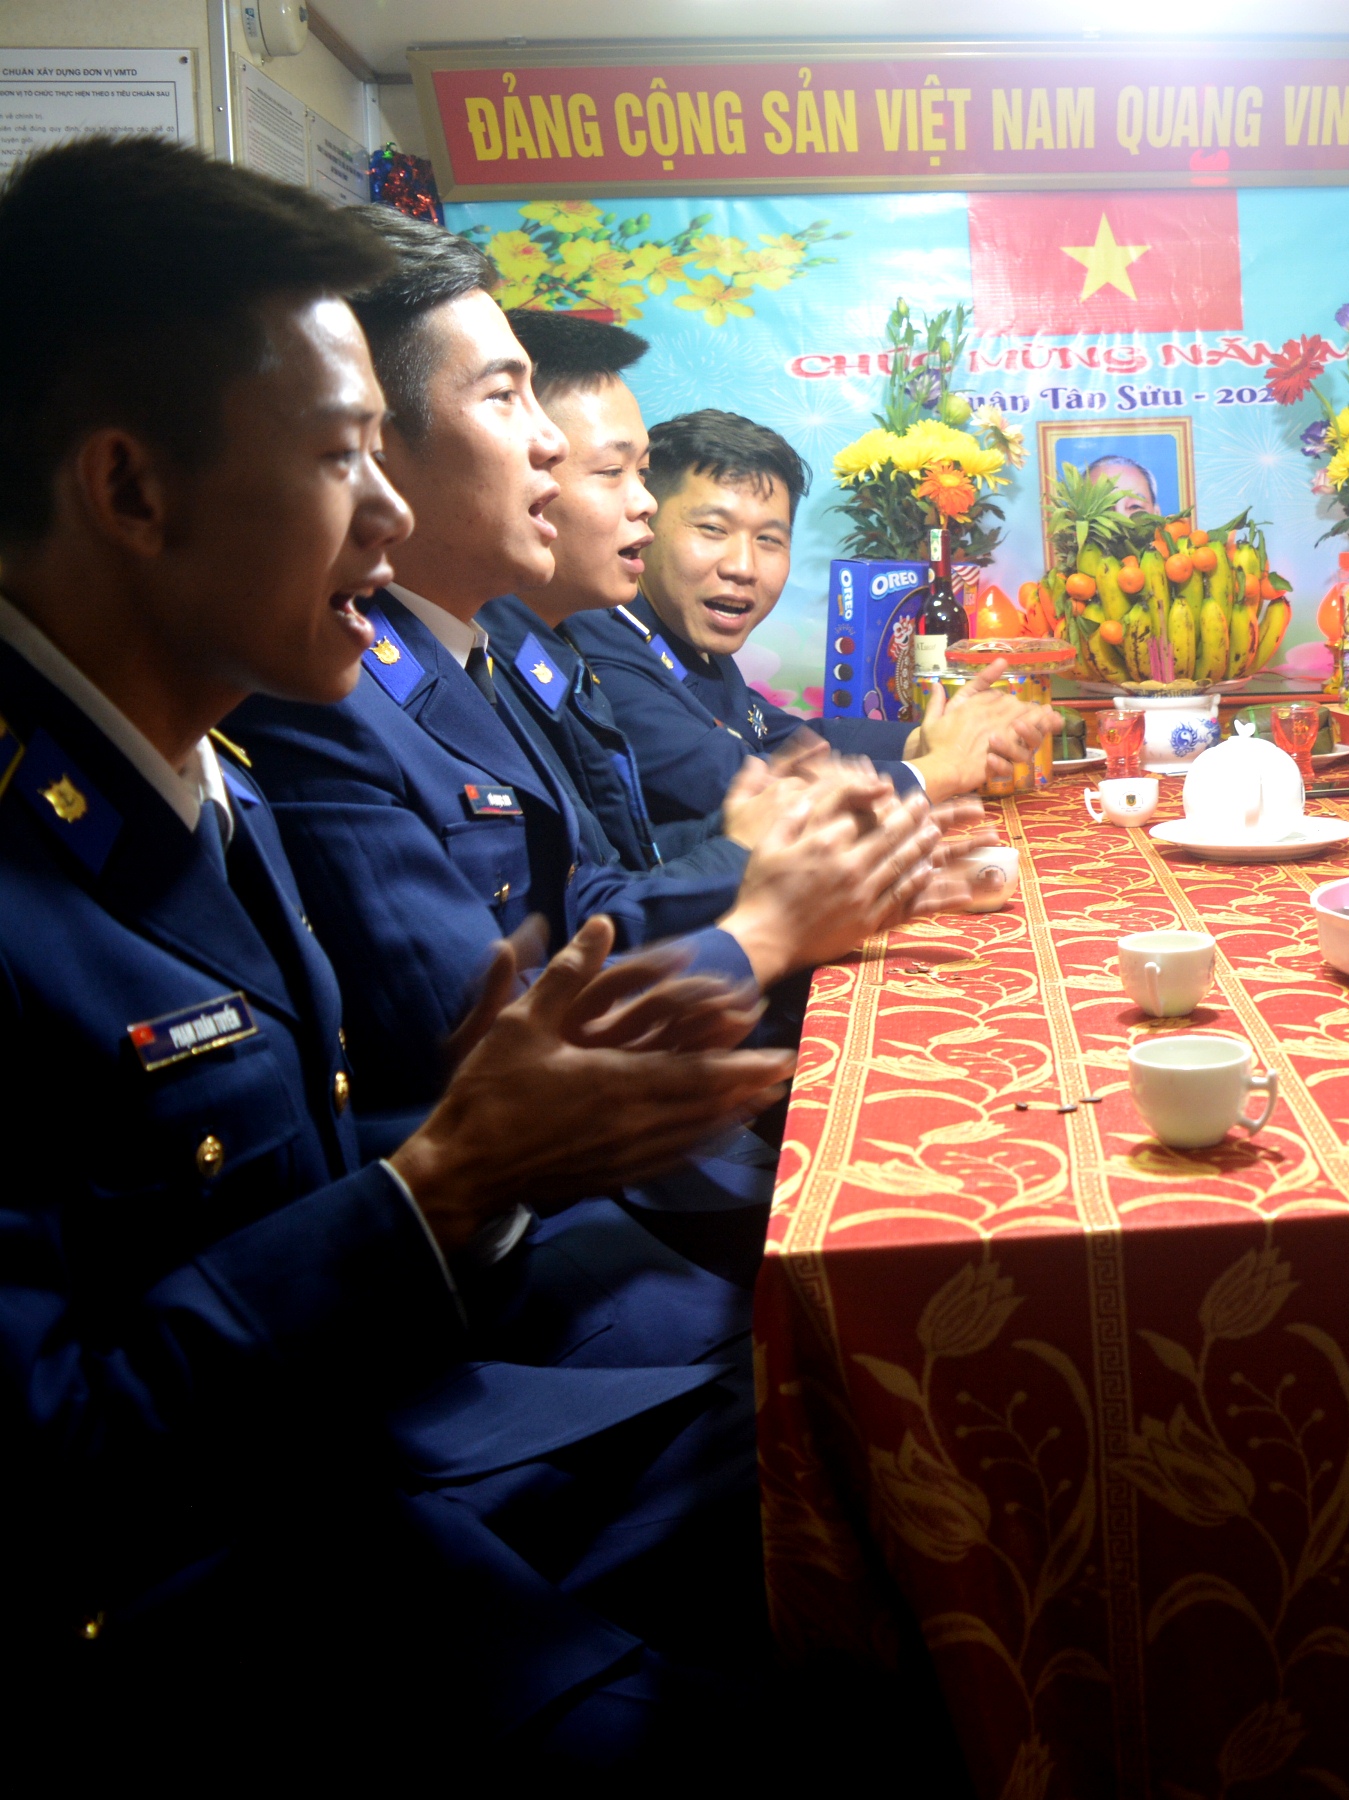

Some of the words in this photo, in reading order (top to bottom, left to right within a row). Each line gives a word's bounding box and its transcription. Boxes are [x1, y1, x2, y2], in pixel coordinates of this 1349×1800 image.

[36, 67, 54, 76] XÂY
[56, 68, 81, 77] DỰNG
[83, 68, 102, 76] ĐƠN
[104, 68, 112, 77] VỊ
[114, 68, 138, 76] VMTD
[464, 72, 604, 161] ĐẢNG
[614, 77, 746, 170] CỘNG
[762, 67, 859, 155] SẢN
[875, 74, 972, 166] VIỆT
[990, 87, 1096, 151] NAM
[1115, 85, 1263, 156] QUANG
[969, 390, 1030, 413] uân
[1040, 387, 1106, 412] Tân
[1216, 387, 1276, 405] 202
[841, 570, 853, 620] OREO
[872, 571, 918, 596] OREO
